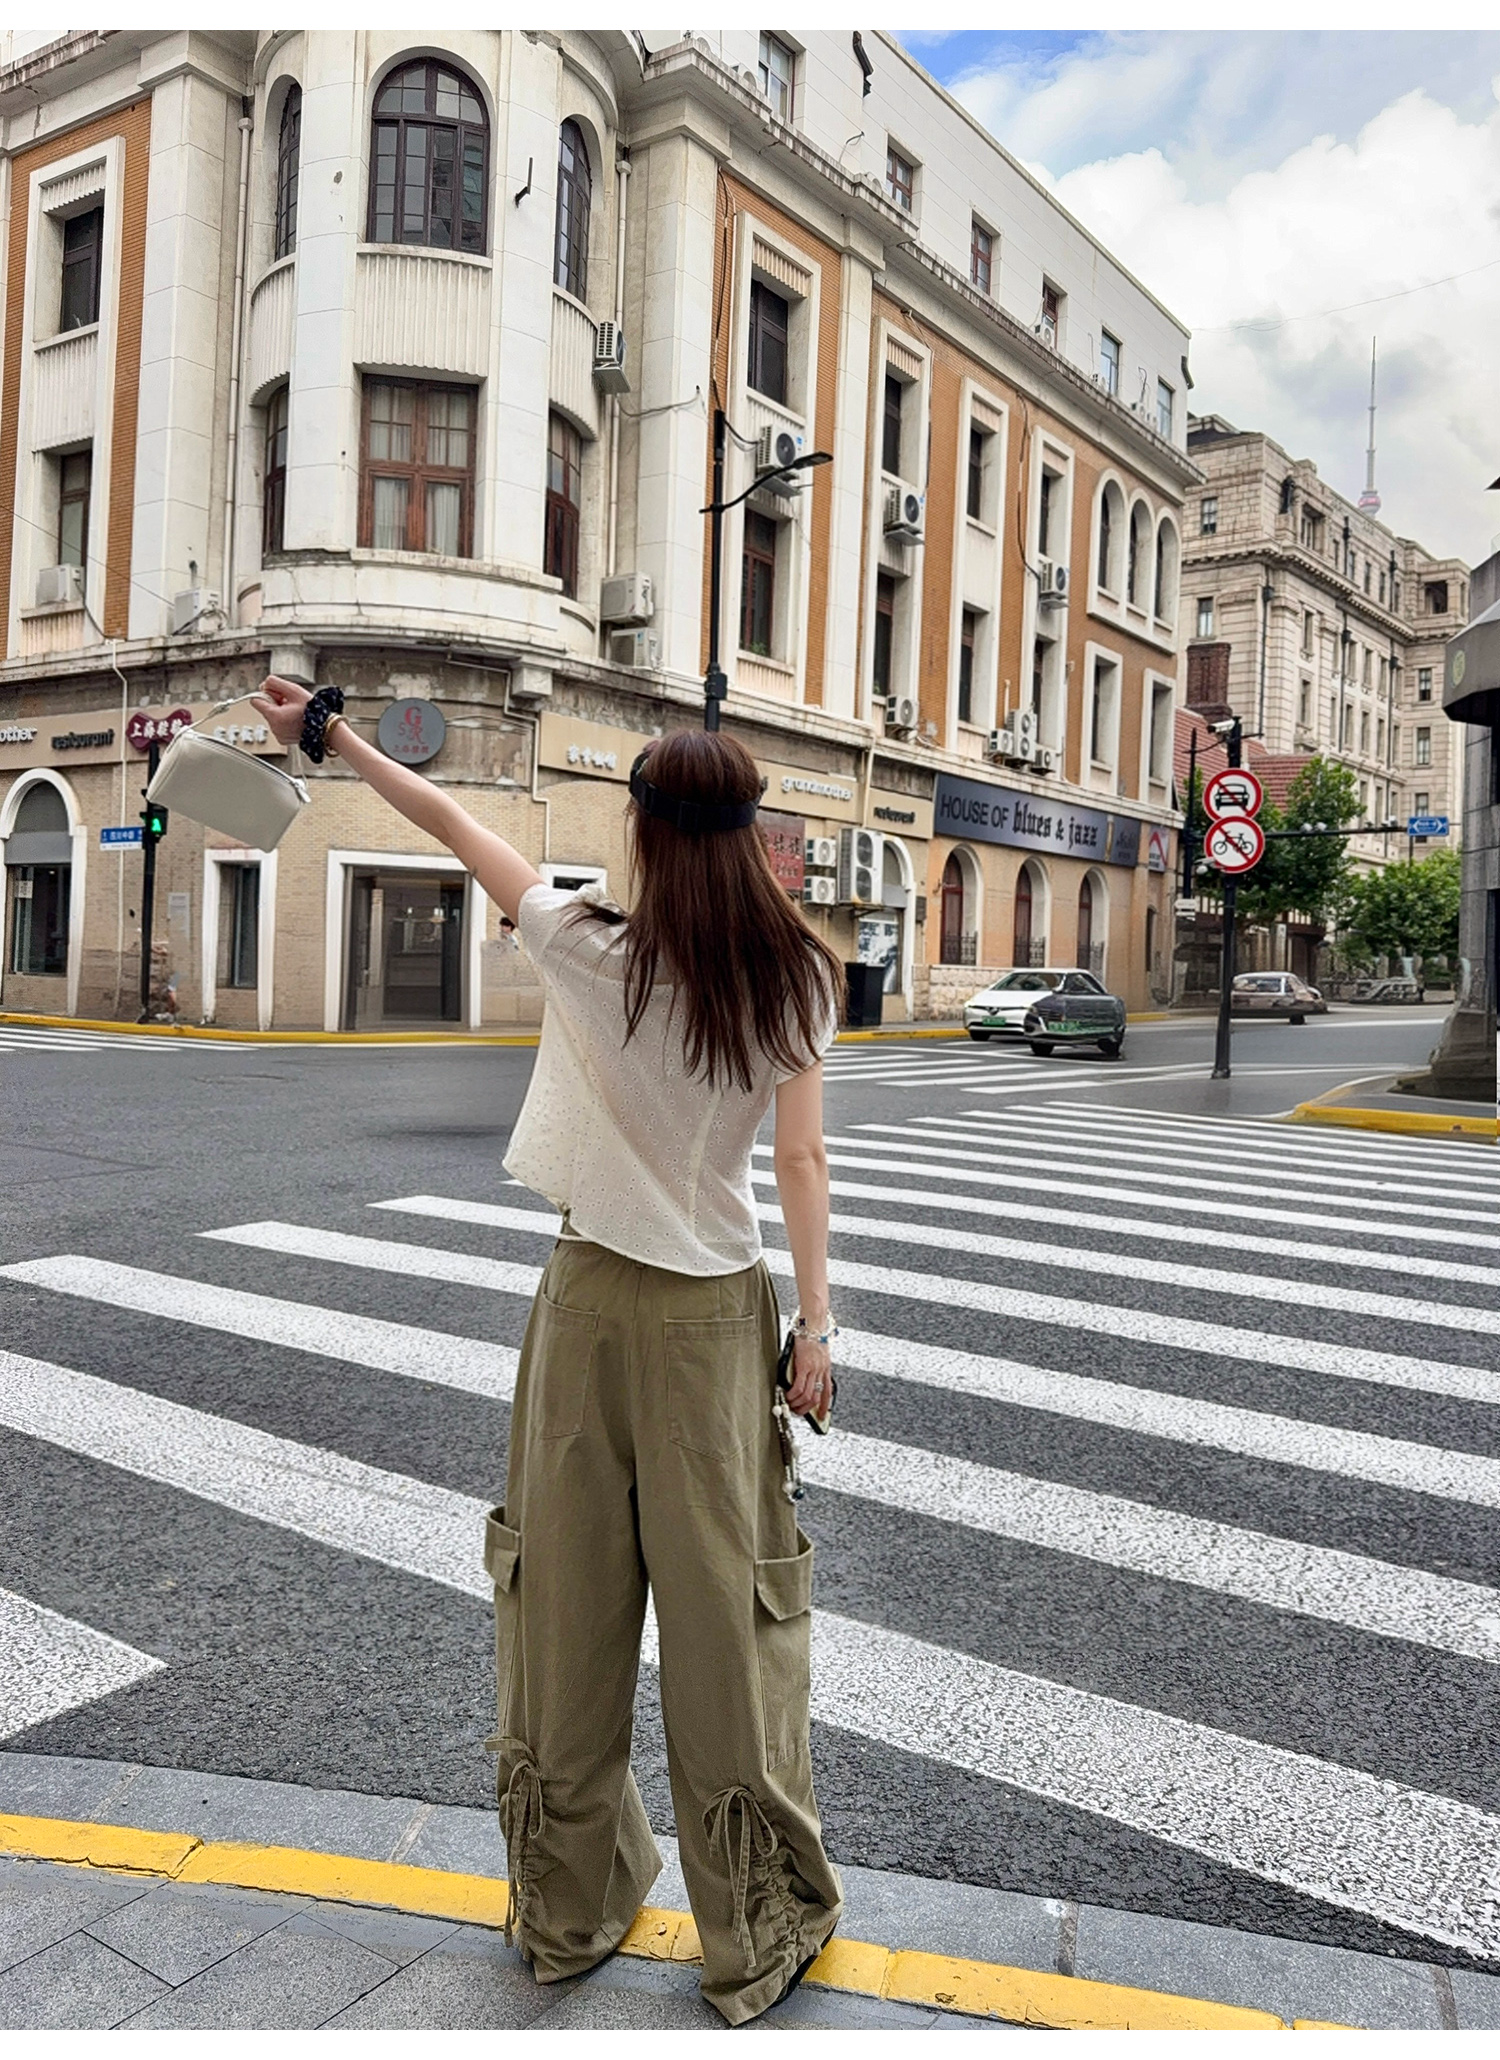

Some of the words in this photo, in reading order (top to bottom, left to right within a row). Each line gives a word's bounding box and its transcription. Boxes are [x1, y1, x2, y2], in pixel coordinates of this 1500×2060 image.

[940, 794, 989, 826] HOUSE
[991, 805, 1009, 829] OF
[1012, 800, 1052, 837] blues
[1055, 818, 1064, 840] &
[1068, 816, 1098, 848] jazz
